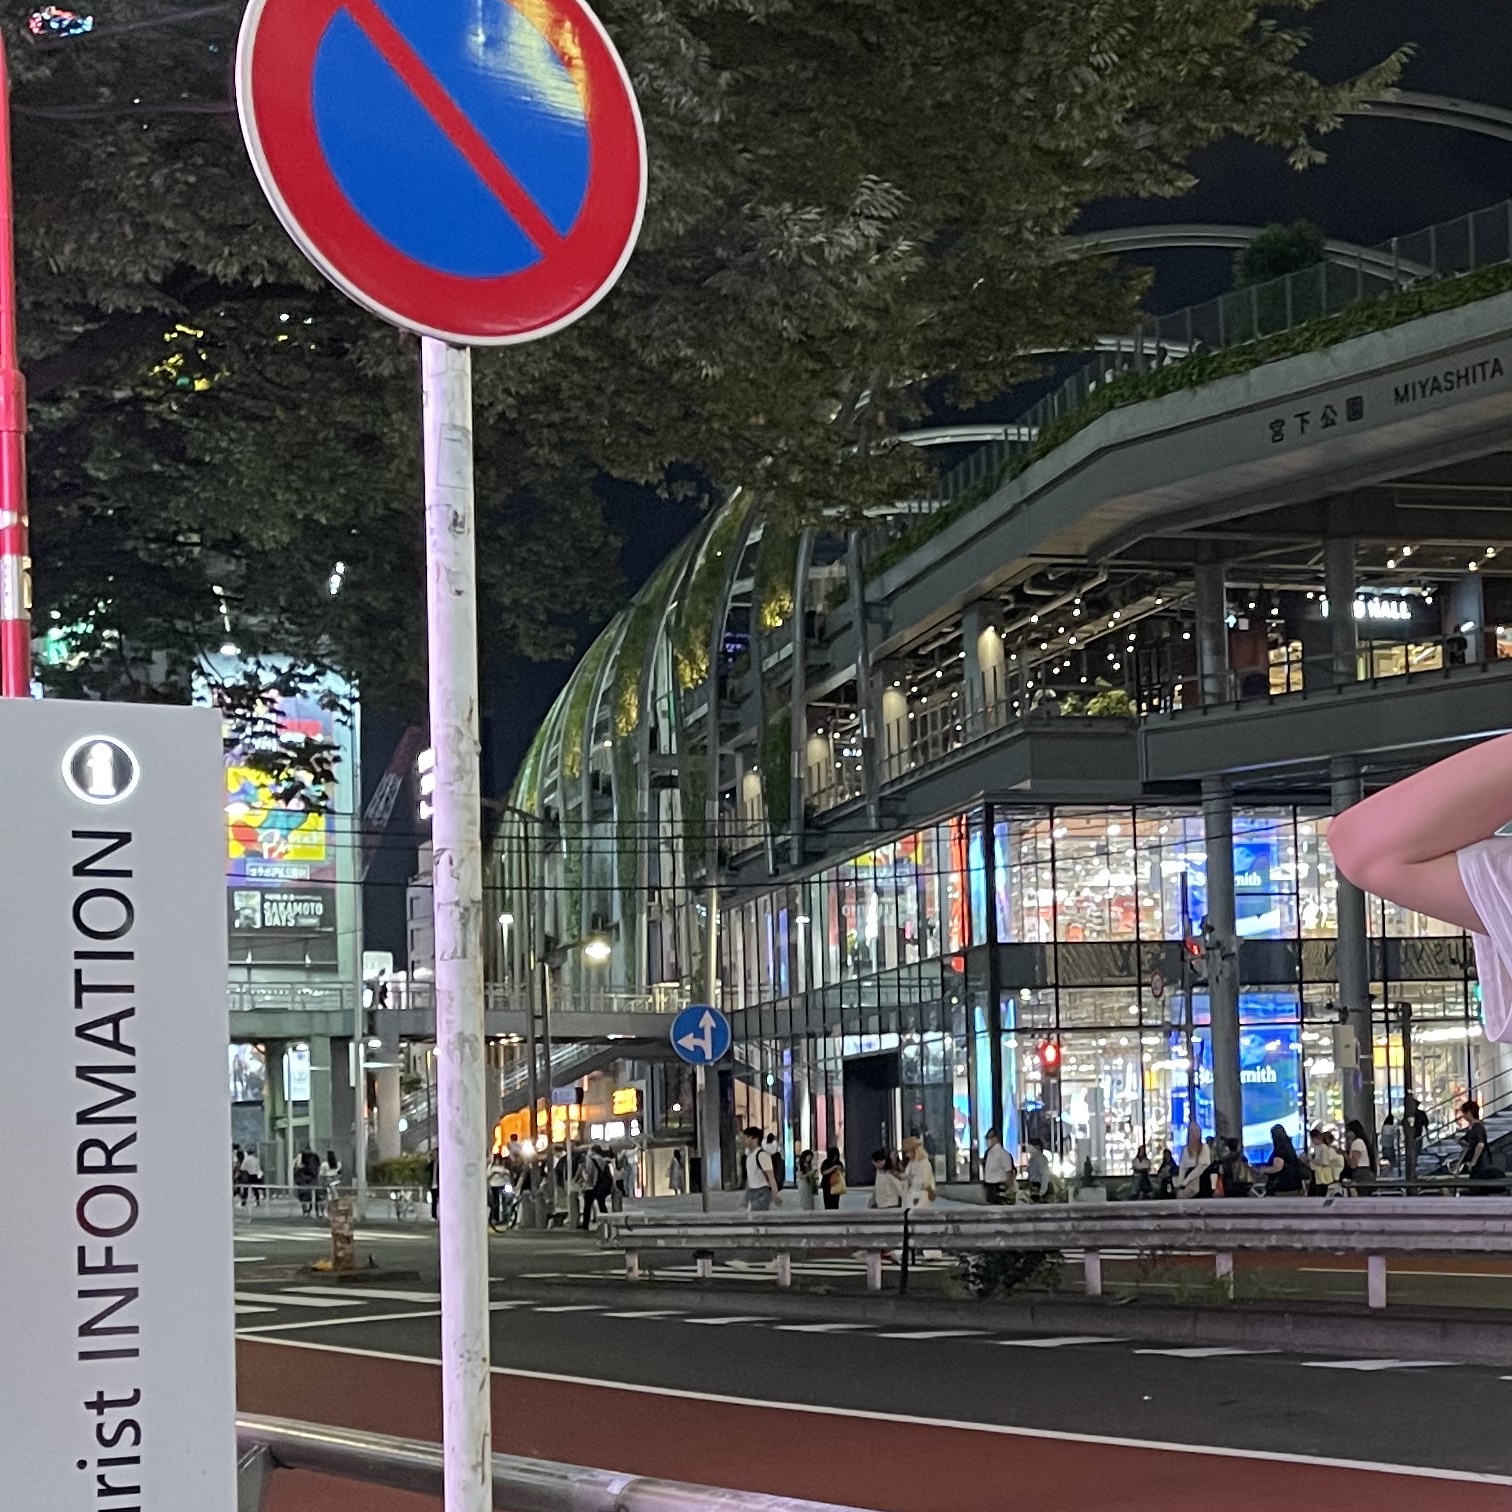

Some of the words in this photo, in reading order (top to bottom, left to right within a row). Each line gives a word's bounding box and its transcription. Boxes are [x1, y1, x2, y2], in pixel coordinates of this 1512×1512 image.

[1393, 357, 1504, 406] MIYASHITA
[263, 901, 324, 916] SAKAMOTO
[264, 910, 296, 928] DAYS
[70, 828, 140, 1361] INFORMATION
